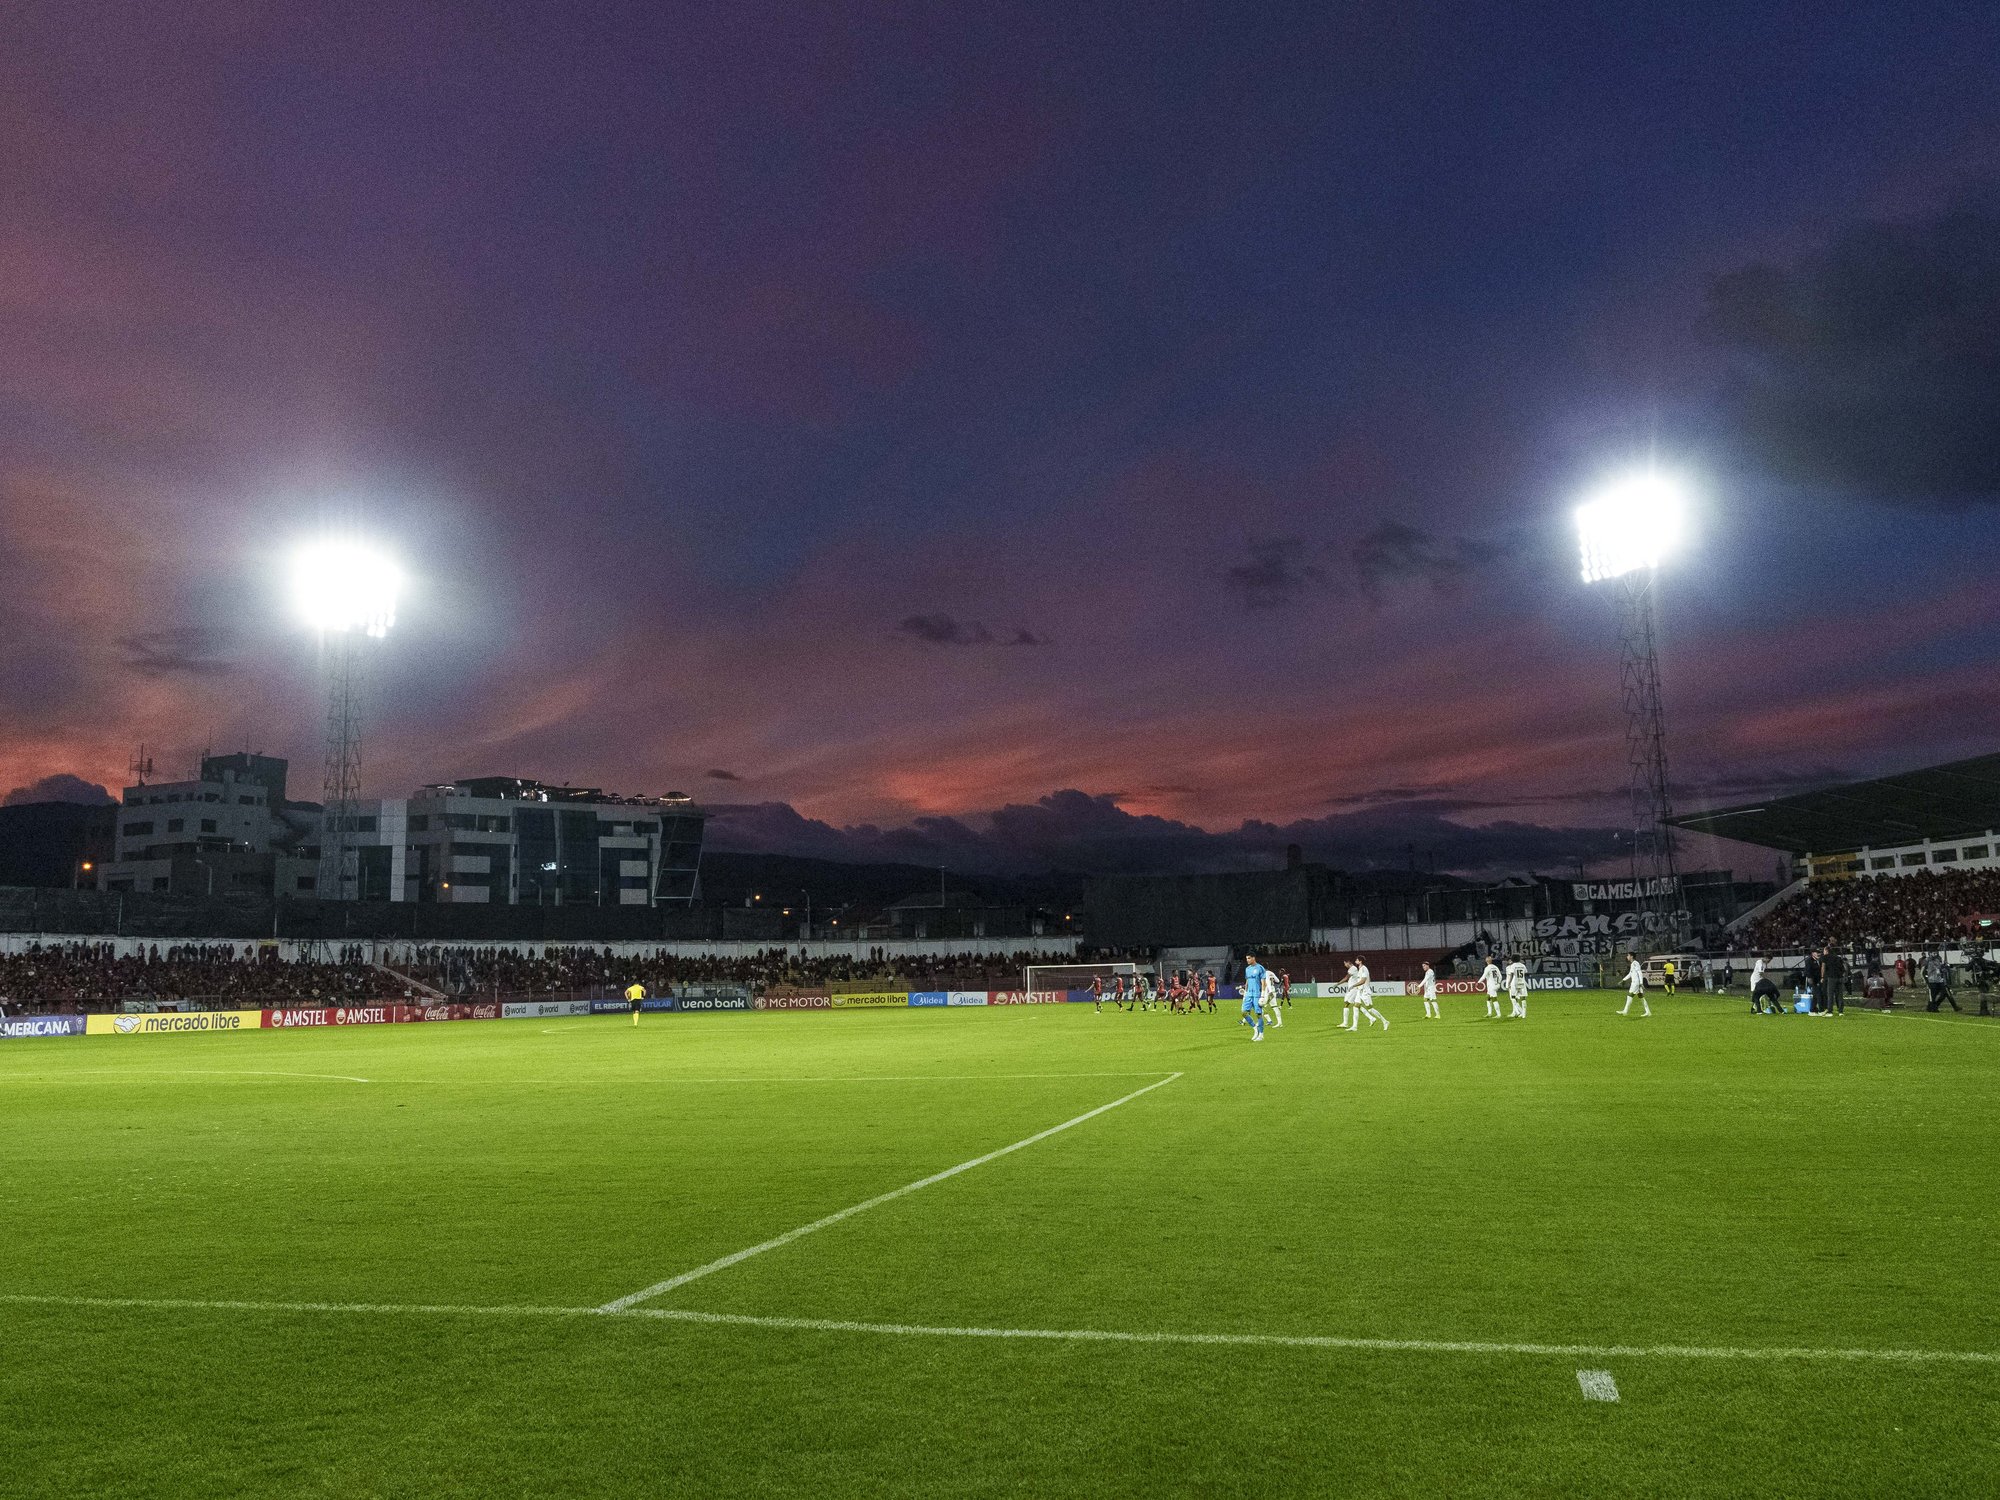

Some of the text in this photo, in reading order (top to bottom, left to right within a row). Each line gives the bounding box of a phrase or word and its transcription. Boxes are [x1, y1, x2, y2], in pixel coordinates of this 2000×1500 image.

[1589, 882, 1643, 899] CAMISA
[1517, 969, 1524, 979] 15
[1447, 981, 1487, 993] MOTO
[1501, 976, 1583, 991] CNMEBOL
[682, 997, 745, 1009] ueno bank
[769, 998, 787, 1008] MG
[789, 997, 831, 1008] MOTOR
[847, 994, 907, 1005] mercado libre
[917, 996, 944, 1005] Midea
[1009, 991, 1059, 1004] AMSTEL
[511, 1005, 527, 1015] world
[544, 1004, 558, 1013] world
[575, 1003, 589, 1012] world
[146, 1013, 240, 1031] mercado libre
[283, 1009, 328, 1026] AMSTEL
[347, 1008, 386, 1024] AMSTEL
